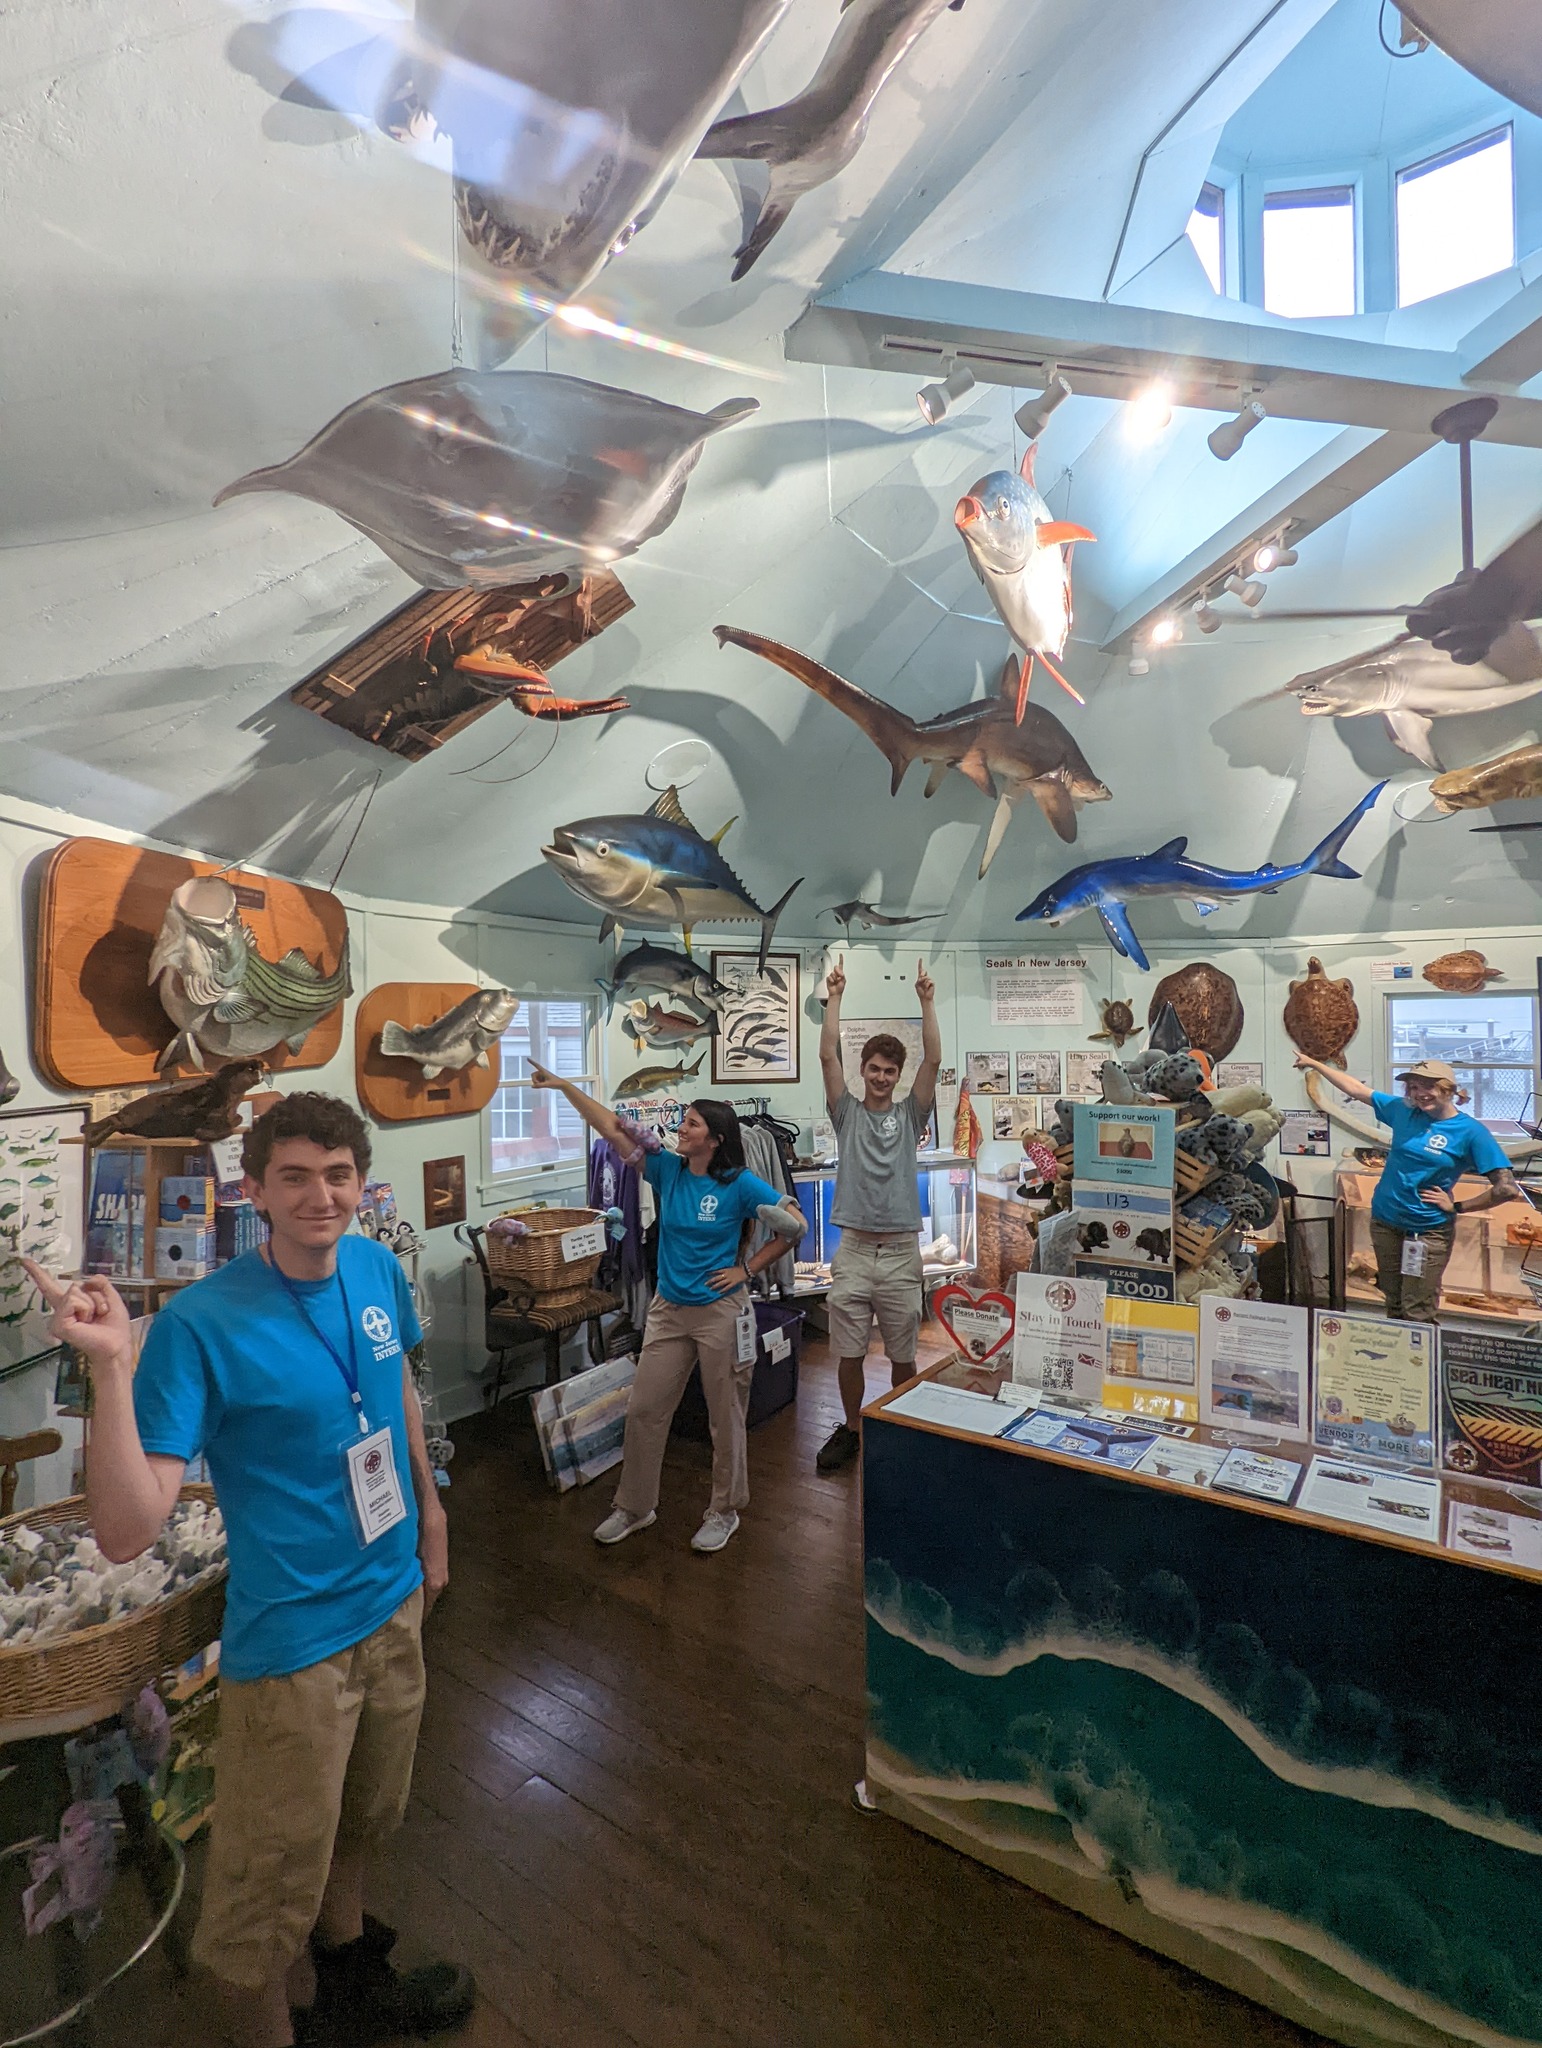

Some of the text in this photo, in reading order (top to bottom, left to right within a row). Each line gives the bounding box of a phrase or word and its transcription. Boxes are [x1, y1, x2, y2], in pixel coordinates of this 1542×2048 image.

[986, 958, 1087, 968] Seals In New Jersey
[1020, 1053, 1038, 1061] Grey
[1089, 1111, 1120, 1120] Support
[1137, 1114, 1160, 1122] work!
[1106, 1193, 1130, 1209] 113
[1109, 1269, 1139, 1279] PLEASE
[1112, 1279, 1169, 1300] FOOD
[954, 1309, 999, 1321] Please Donate
[1020, 1310, 1101, 1330] Stay in Touch
[374, 1345, 401, 1361] INTERN
[1442, 1342, 1485, 1353] opportunity
[1496, 1349, 1517, 1358] score
[1448, 1349, 1473, 1359] tickets
[1500, 1357, 1533, 1366] sold-out
[1319, 1428, 1354, 1440] VENDOR
[1378, 1440, 1410, 1453] MORE
